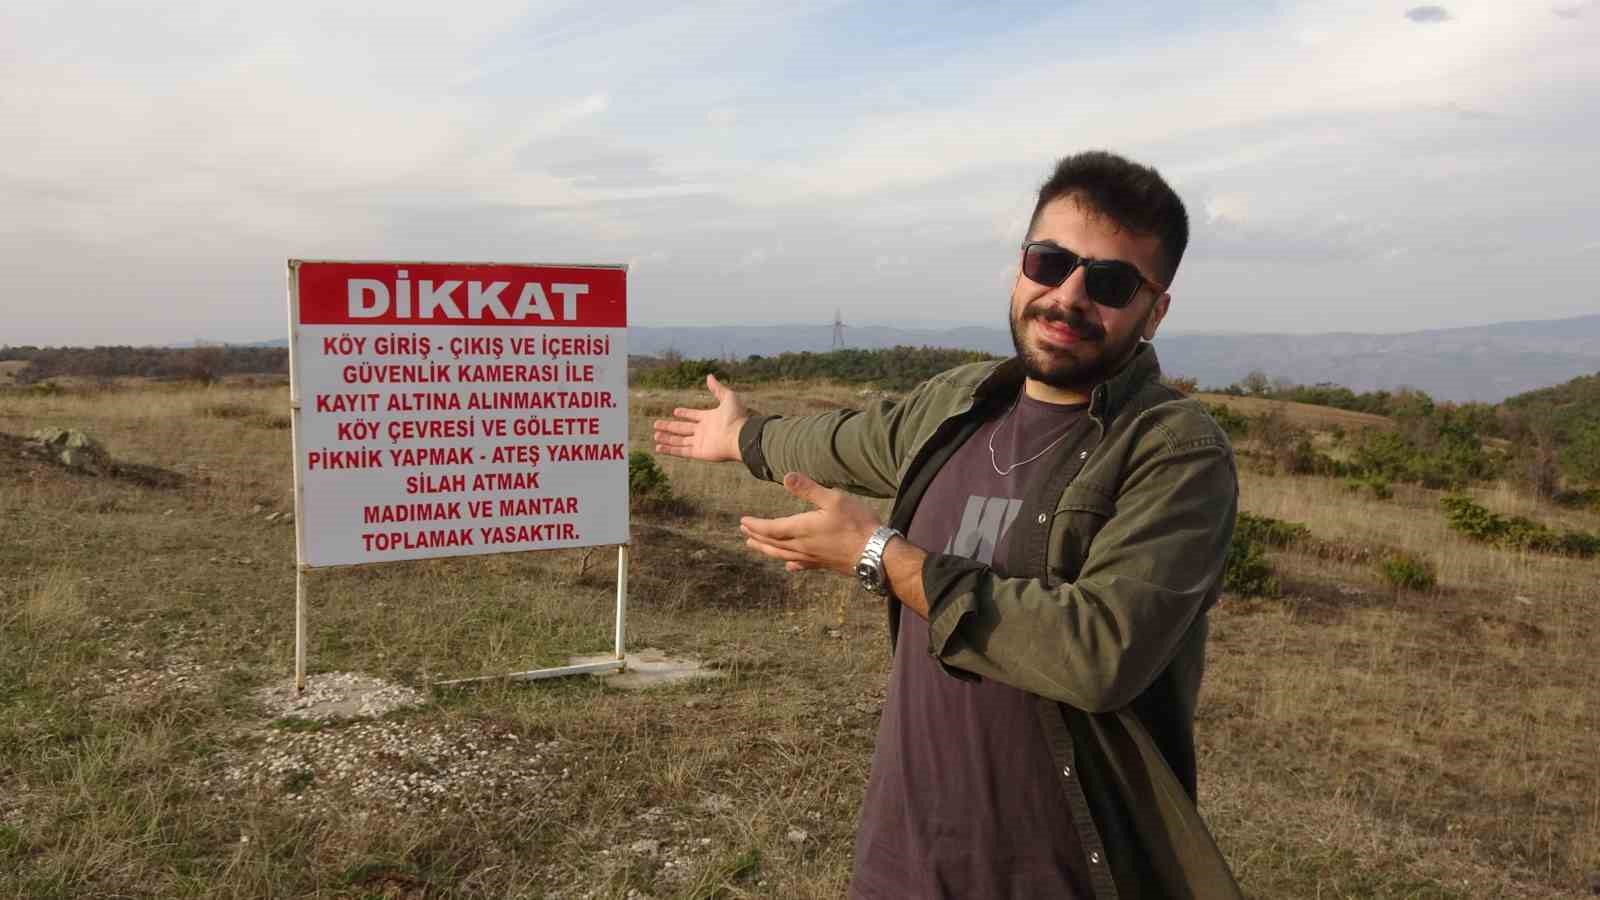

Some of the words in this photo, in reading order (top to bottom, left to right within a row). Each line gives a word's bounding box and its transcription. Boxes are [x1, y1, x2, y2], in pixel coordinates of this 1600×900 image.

[348, 270, 588, 320] DİKKAT
[324, 333, 366, 355] KÖY
[374, 333, 430, 360] GİRİŞ
[450, 337, 504, 360] ÇIKIŞ
[510, 338, 535, 355] VE
[542, 334, 609, 360] İÇERİSİ
[343, 361, 451, 384] GÜVENLİK
[458, 365, 558, 383] KAMERASI
[566, 361, 594, 382] İLE
[317, 394, 380, 412] KAYIT
[387, 393, 461, 411] ALTINA
[467, 392, 616, 410] ALINMAKTADIR.
[338, 418, 381, 440] KÖY
[388, 416, 474, 444] ÇEVRESİ
[481, 419, 507, 437] VE
[513, 416, 599, 436] GÖLETTE
[308, 446, 382, 470] PİKNİK
[389, 447, 474, 467] YAPMAK
[492, 445, 540, 467] ATEŞ
[547, 443, 624, 462] YAKMAK
[406, 472, 465, 494] SİLAH
[472, 472, 539, 491] ATMAK
[364, 502, 461, 524] MADIMAK
[468, 500, 493, 518] VE
[499, 497, 578, 517] MANTAR
[362, 528, 474, 552] TOPLAMAK
[480, 523, 580, 544] YASAKTIR.
